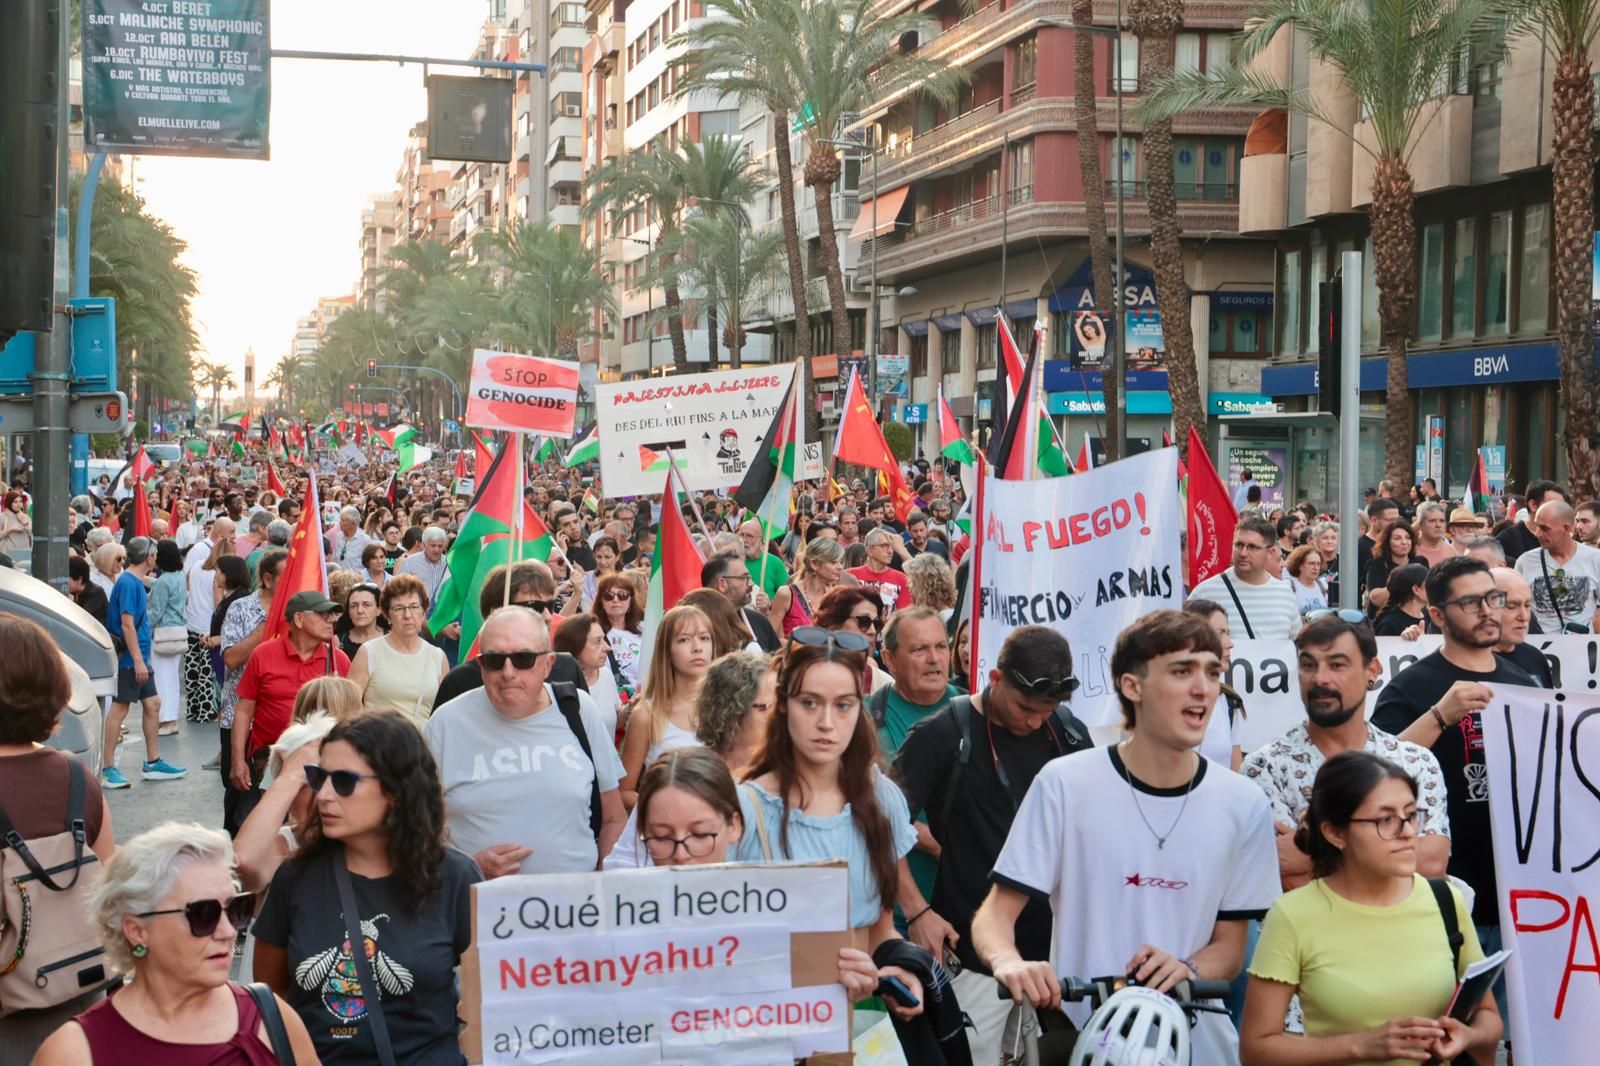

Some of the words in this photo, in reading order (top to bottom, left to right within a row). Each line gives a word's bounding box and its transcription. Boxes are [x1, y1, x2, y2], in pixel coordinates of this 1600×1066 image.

[142, 2, 168, 13] 4.OCT
[173, 1, 211, 16] BERET
[88, 14, 115, 25] 5.OCT
[119, 12, 184, 30] MALINCHE
[189, 17, 263, 35] SYMPHONIC
[125, 32, 155, 44] 12.OCT
[160, 31, 186, 46] ANA
[191, 32, 229, 48] BELÉN
[140, 45, 215, 63] RUMBAVIVA
[220, 50, 249, 65] FEST
[110, 69, 134, 80] 6.DIC
[138, 67, 162, 82] THE
[167, 69, 245, 86] WATERBOYS
[138, 116, 221, 130] ELMUELLELIVE.COM
[1219, 296, 1265, 305] SEGUROS
[1474, 353, 1509, 376] BBVA
[503, 368, 548, 387] STOP
[478, 388, 567, 411] GENOCIDE
[615, 420, 637, 432] DES
[640, 417, 662, 430] DEL
[665, 415, 686, 427] RIU
[689, 412, 715, 424] FINS
[720, 411, 728, 421] A
[732, 409, 748, 420] LA
[1230, 456, 1240, 464] de
[1244, 449, 1269, 458] seguro
[1487, 447, 1501, 466] Ya
[1023, 492, 1151, 552] FUEGO!
[1096, 564, 1173, 608] ARMAS
[472, 744, 584, 781] ASICS
[492, 895, 600, 939] ¿Qué
[616, 894, 660, 926] ha
[673, 881, 787, 917] hecho
[499, 936, 740, 991] Netanyahu?
[494, 1026, 523, 1056] a)
[528, 1020, 655, 1051] Cometer
[671, 1000, 833, 1034] GENOCIDIO
